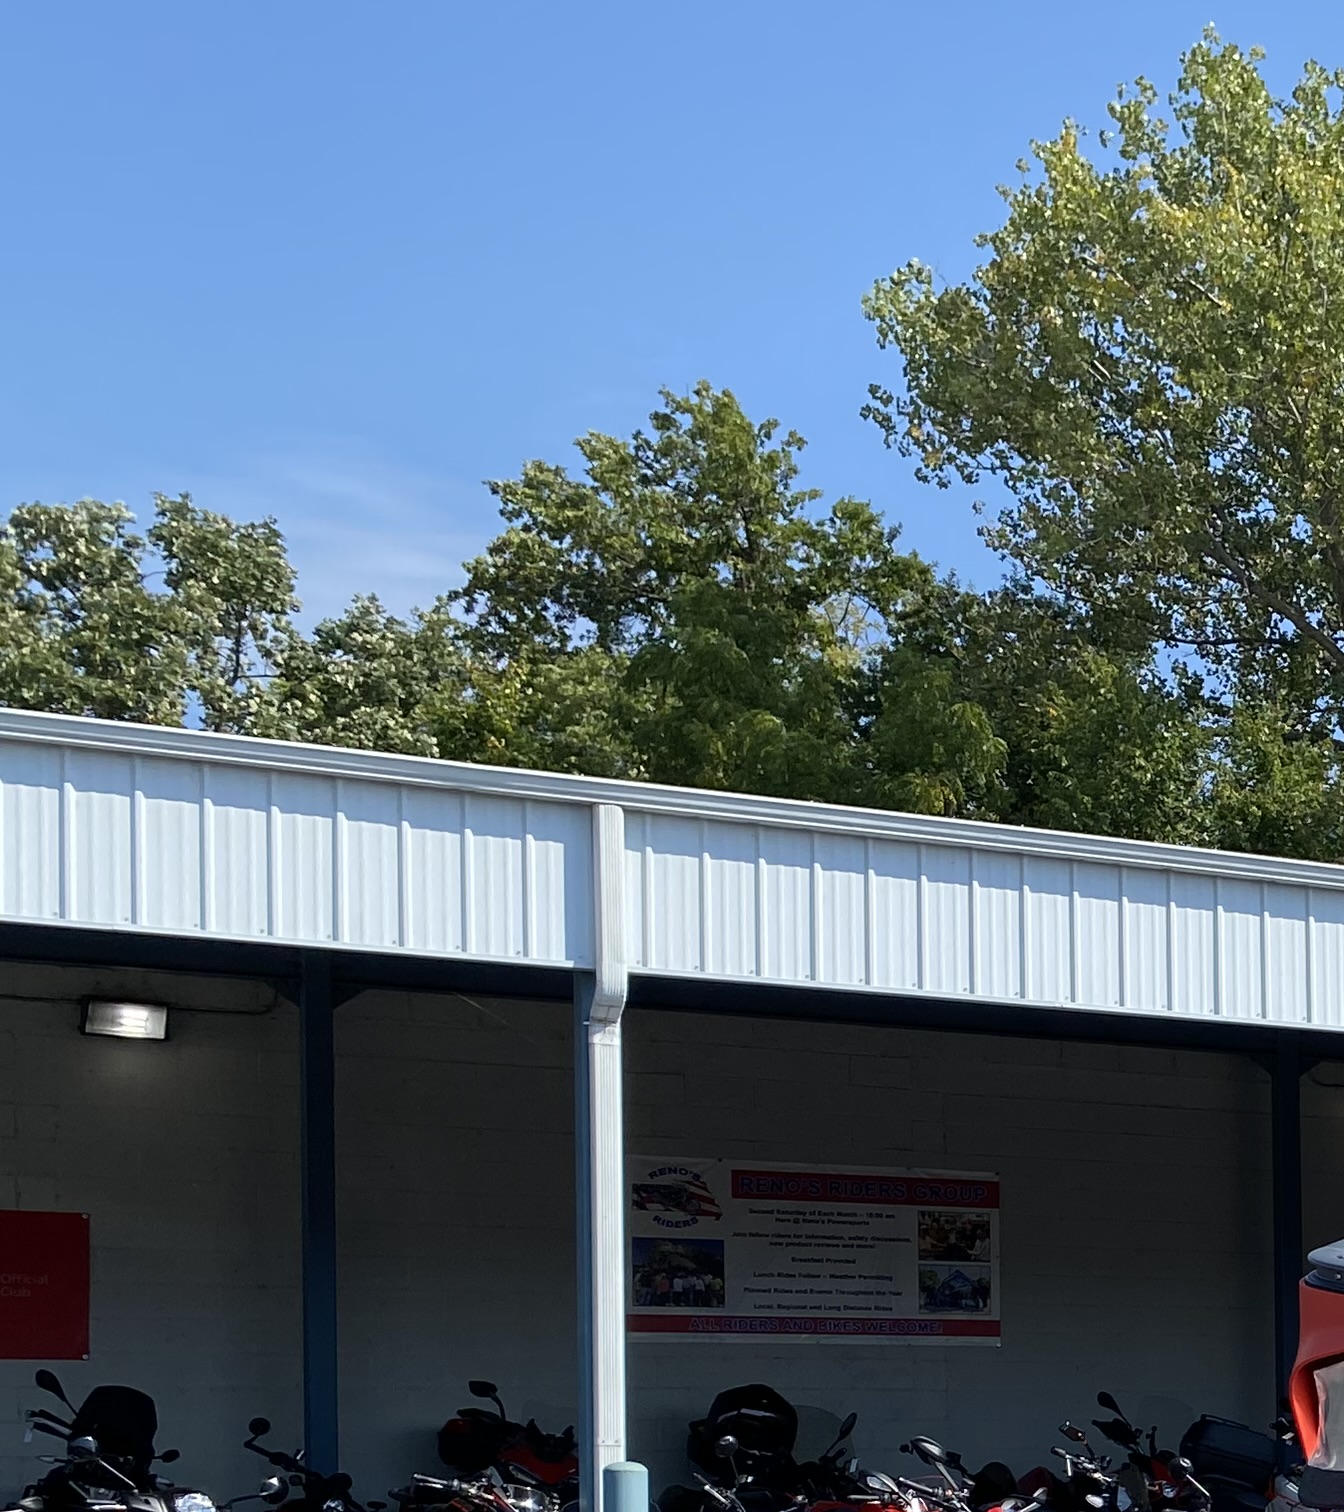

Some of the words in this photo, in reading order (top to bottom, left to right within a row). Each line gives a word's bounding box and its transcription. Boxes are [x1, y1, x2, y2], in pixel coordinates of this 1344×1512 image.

[648, 1167, 701, 1181] RENO'S
[740, 1176, 821, 1197] RENO'S
[829, 1180, 906, 1200] RIDERS
[913, 1182, 988, 1203] GROUP
[653, 1215, 699, 1228] RIDERS
[0, 1272, 48, 1285] Official
[0, 1286, 31, 1298] Club
[689, 1318, 719, 1331] ALL
[723, 1318, 778, 1332] RIDERS
[782, 1319, 813, 1333] AND
[818, 1320, 861, 1333] BIKES
[865, 1321, 944, 1335] WELCOME!
